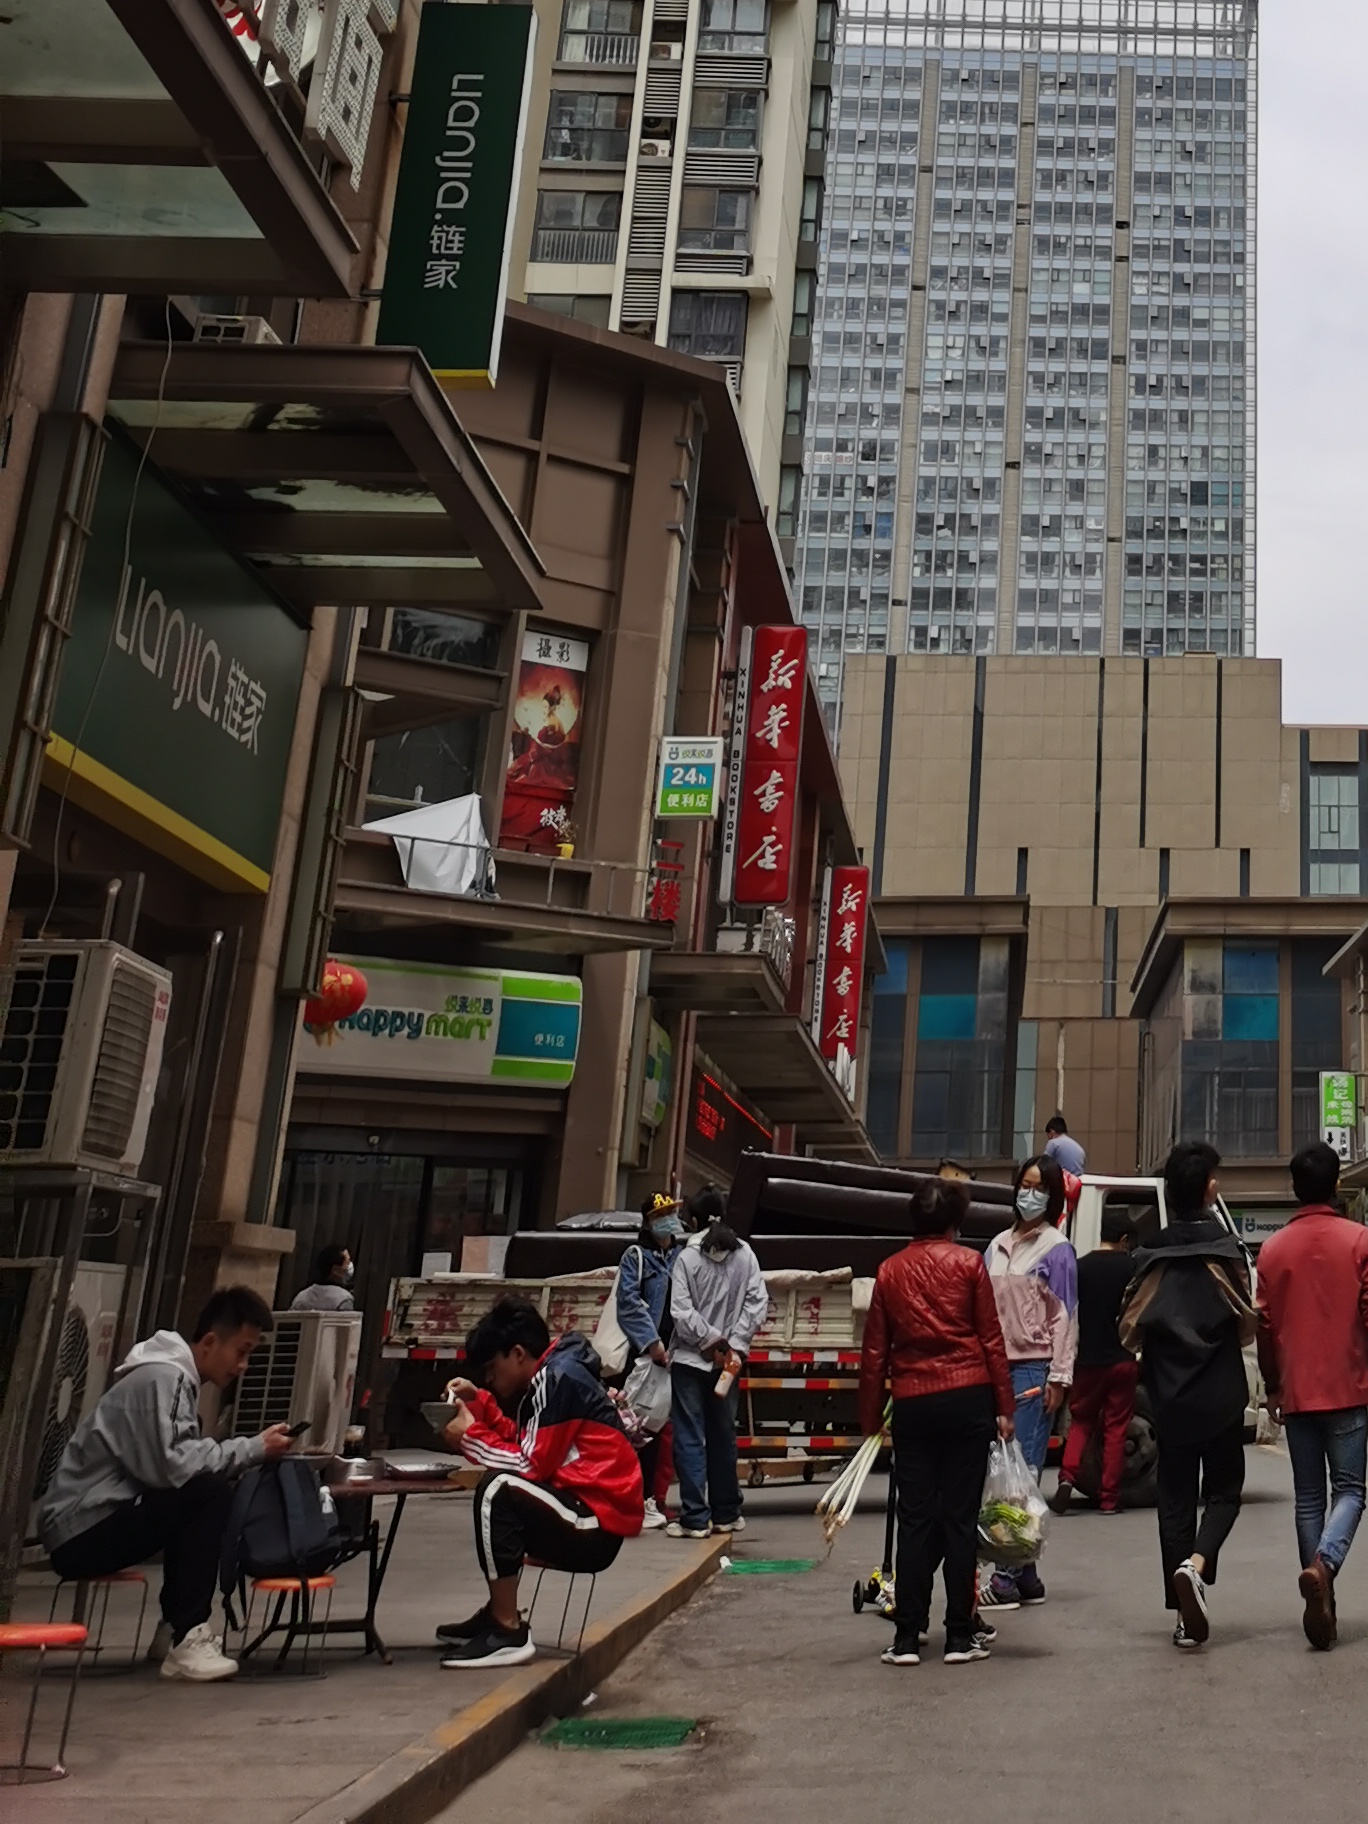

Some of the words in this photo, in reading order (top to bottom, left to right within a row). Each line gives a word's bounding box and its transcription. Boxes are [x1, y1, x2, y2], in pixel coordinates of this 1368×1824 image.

[422, 224, 467, 289] 链家
[221, 657, 267, 756] 链家
[732, 666, 748, 736] XINHUA
[666, 792, 710, 809] 便利店
[670, 766, 707, 786] 24h
[725, 748, 741, 854] BOOKSTORE
[534, 1033, 566, 1048] 便利店
